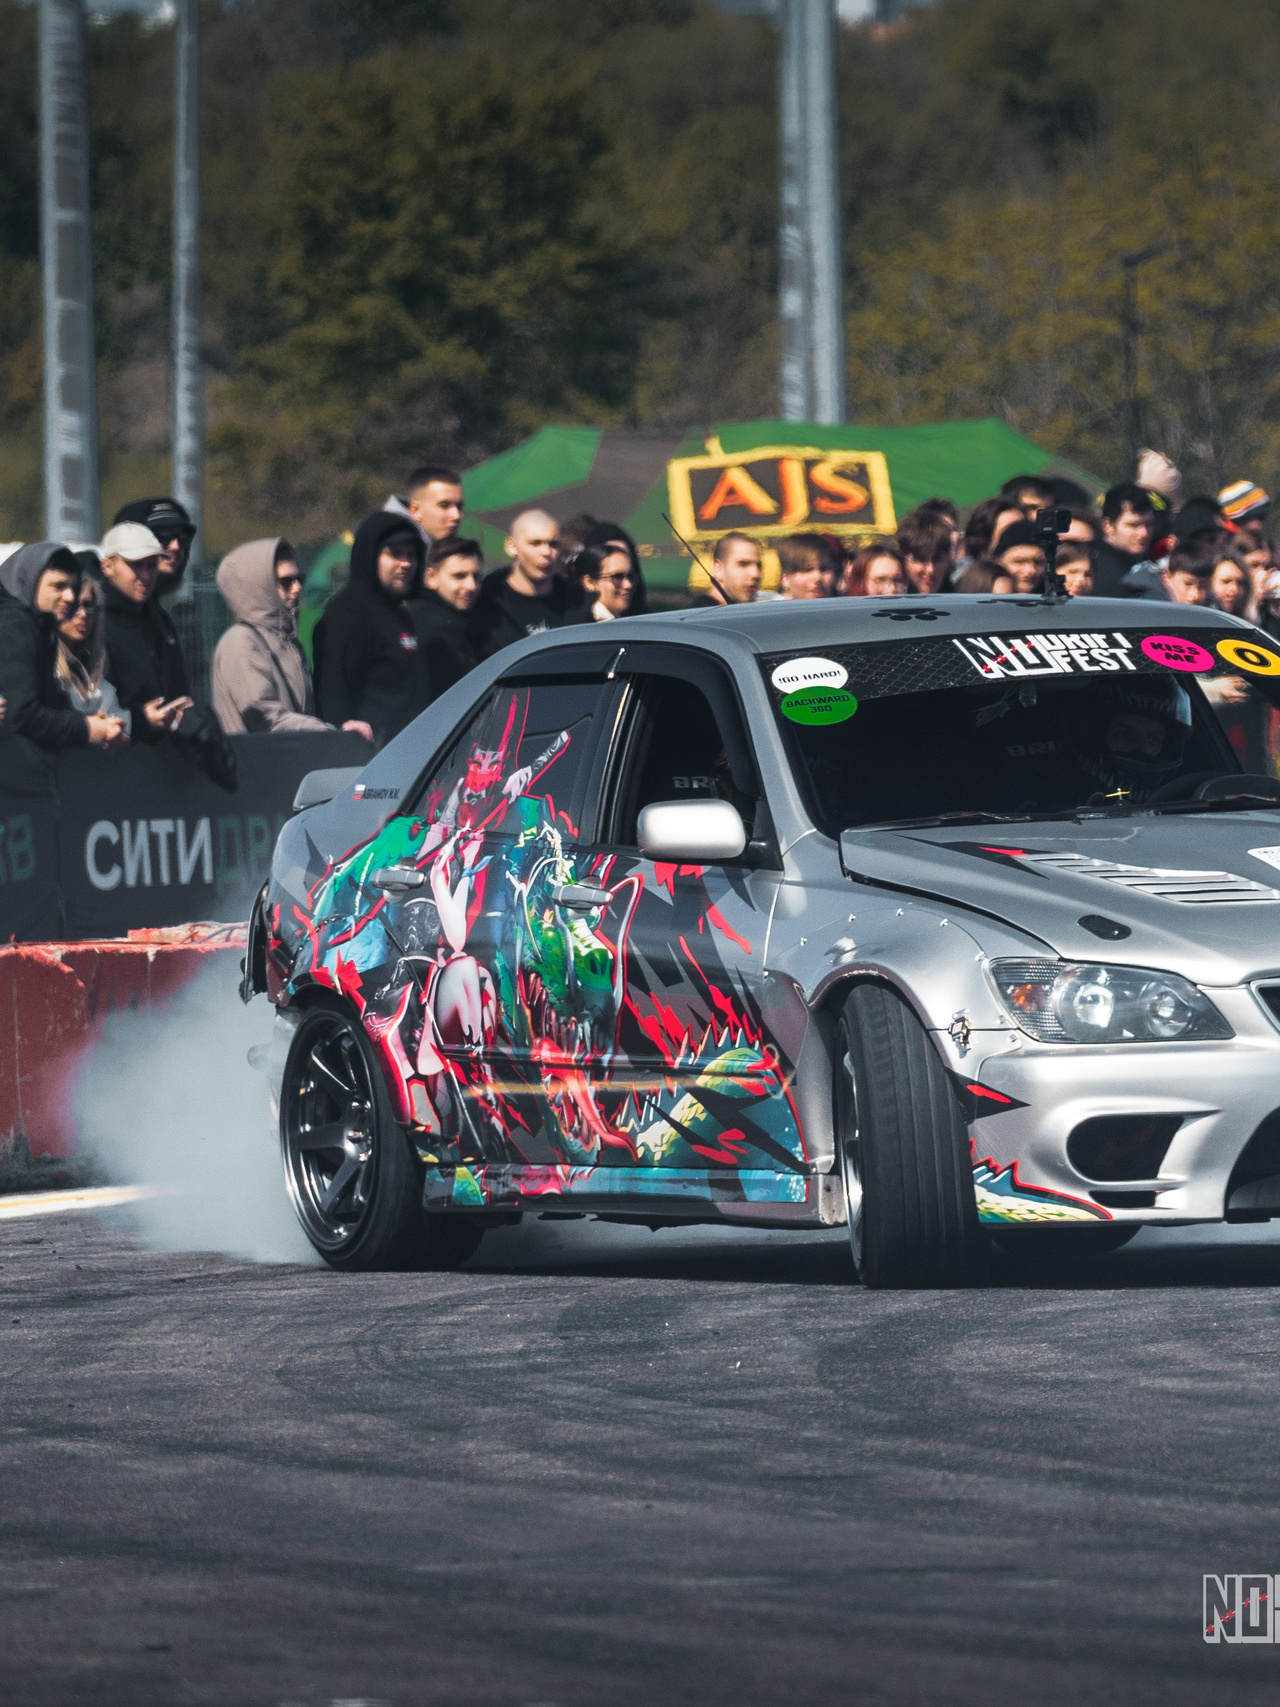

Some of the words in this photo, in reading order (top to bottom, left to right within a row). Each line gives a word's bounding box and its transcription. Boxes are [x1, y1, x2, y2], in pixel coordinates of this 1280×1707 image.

[698, 457, 870, 525] AJS
[1149, 642, 1201, 656] KISS
[1049, 649, 1137, 673] FEST
[1164, 653, 1197, 664] ME
[785, 694, 850, 708] BACKWARD
[810, 705, 833, 713] 360
